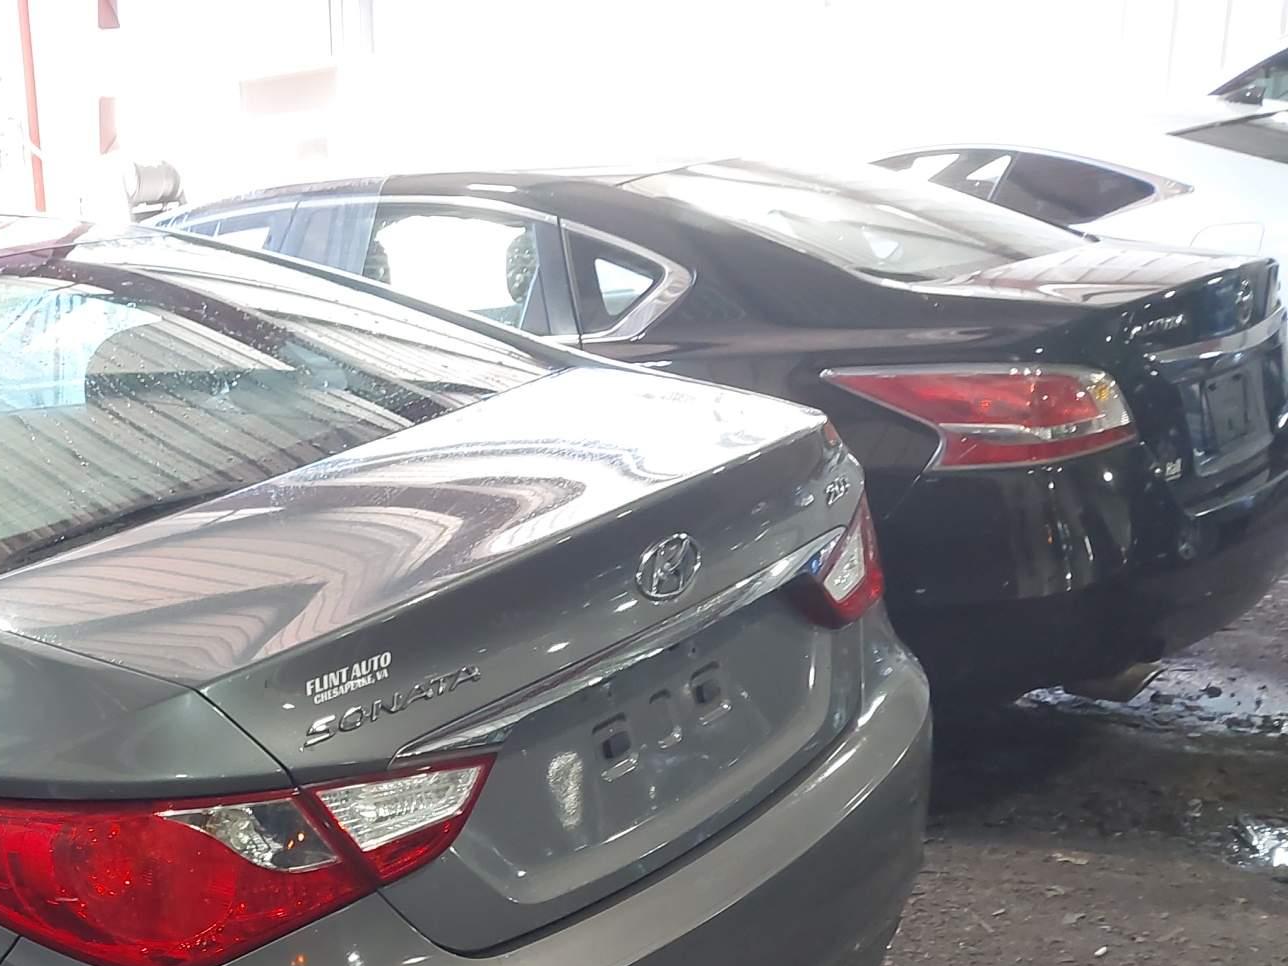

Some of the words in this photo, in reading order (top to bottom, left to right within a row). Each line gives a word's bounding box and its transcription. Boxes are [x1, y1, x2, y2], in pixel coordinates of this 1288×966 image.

[305, 666, 349, 696] FLINT
[350, 651, 392, 680] AUTO
[376, 668, 389, 681] VA
[304, 664, 481, 748] SONATA
